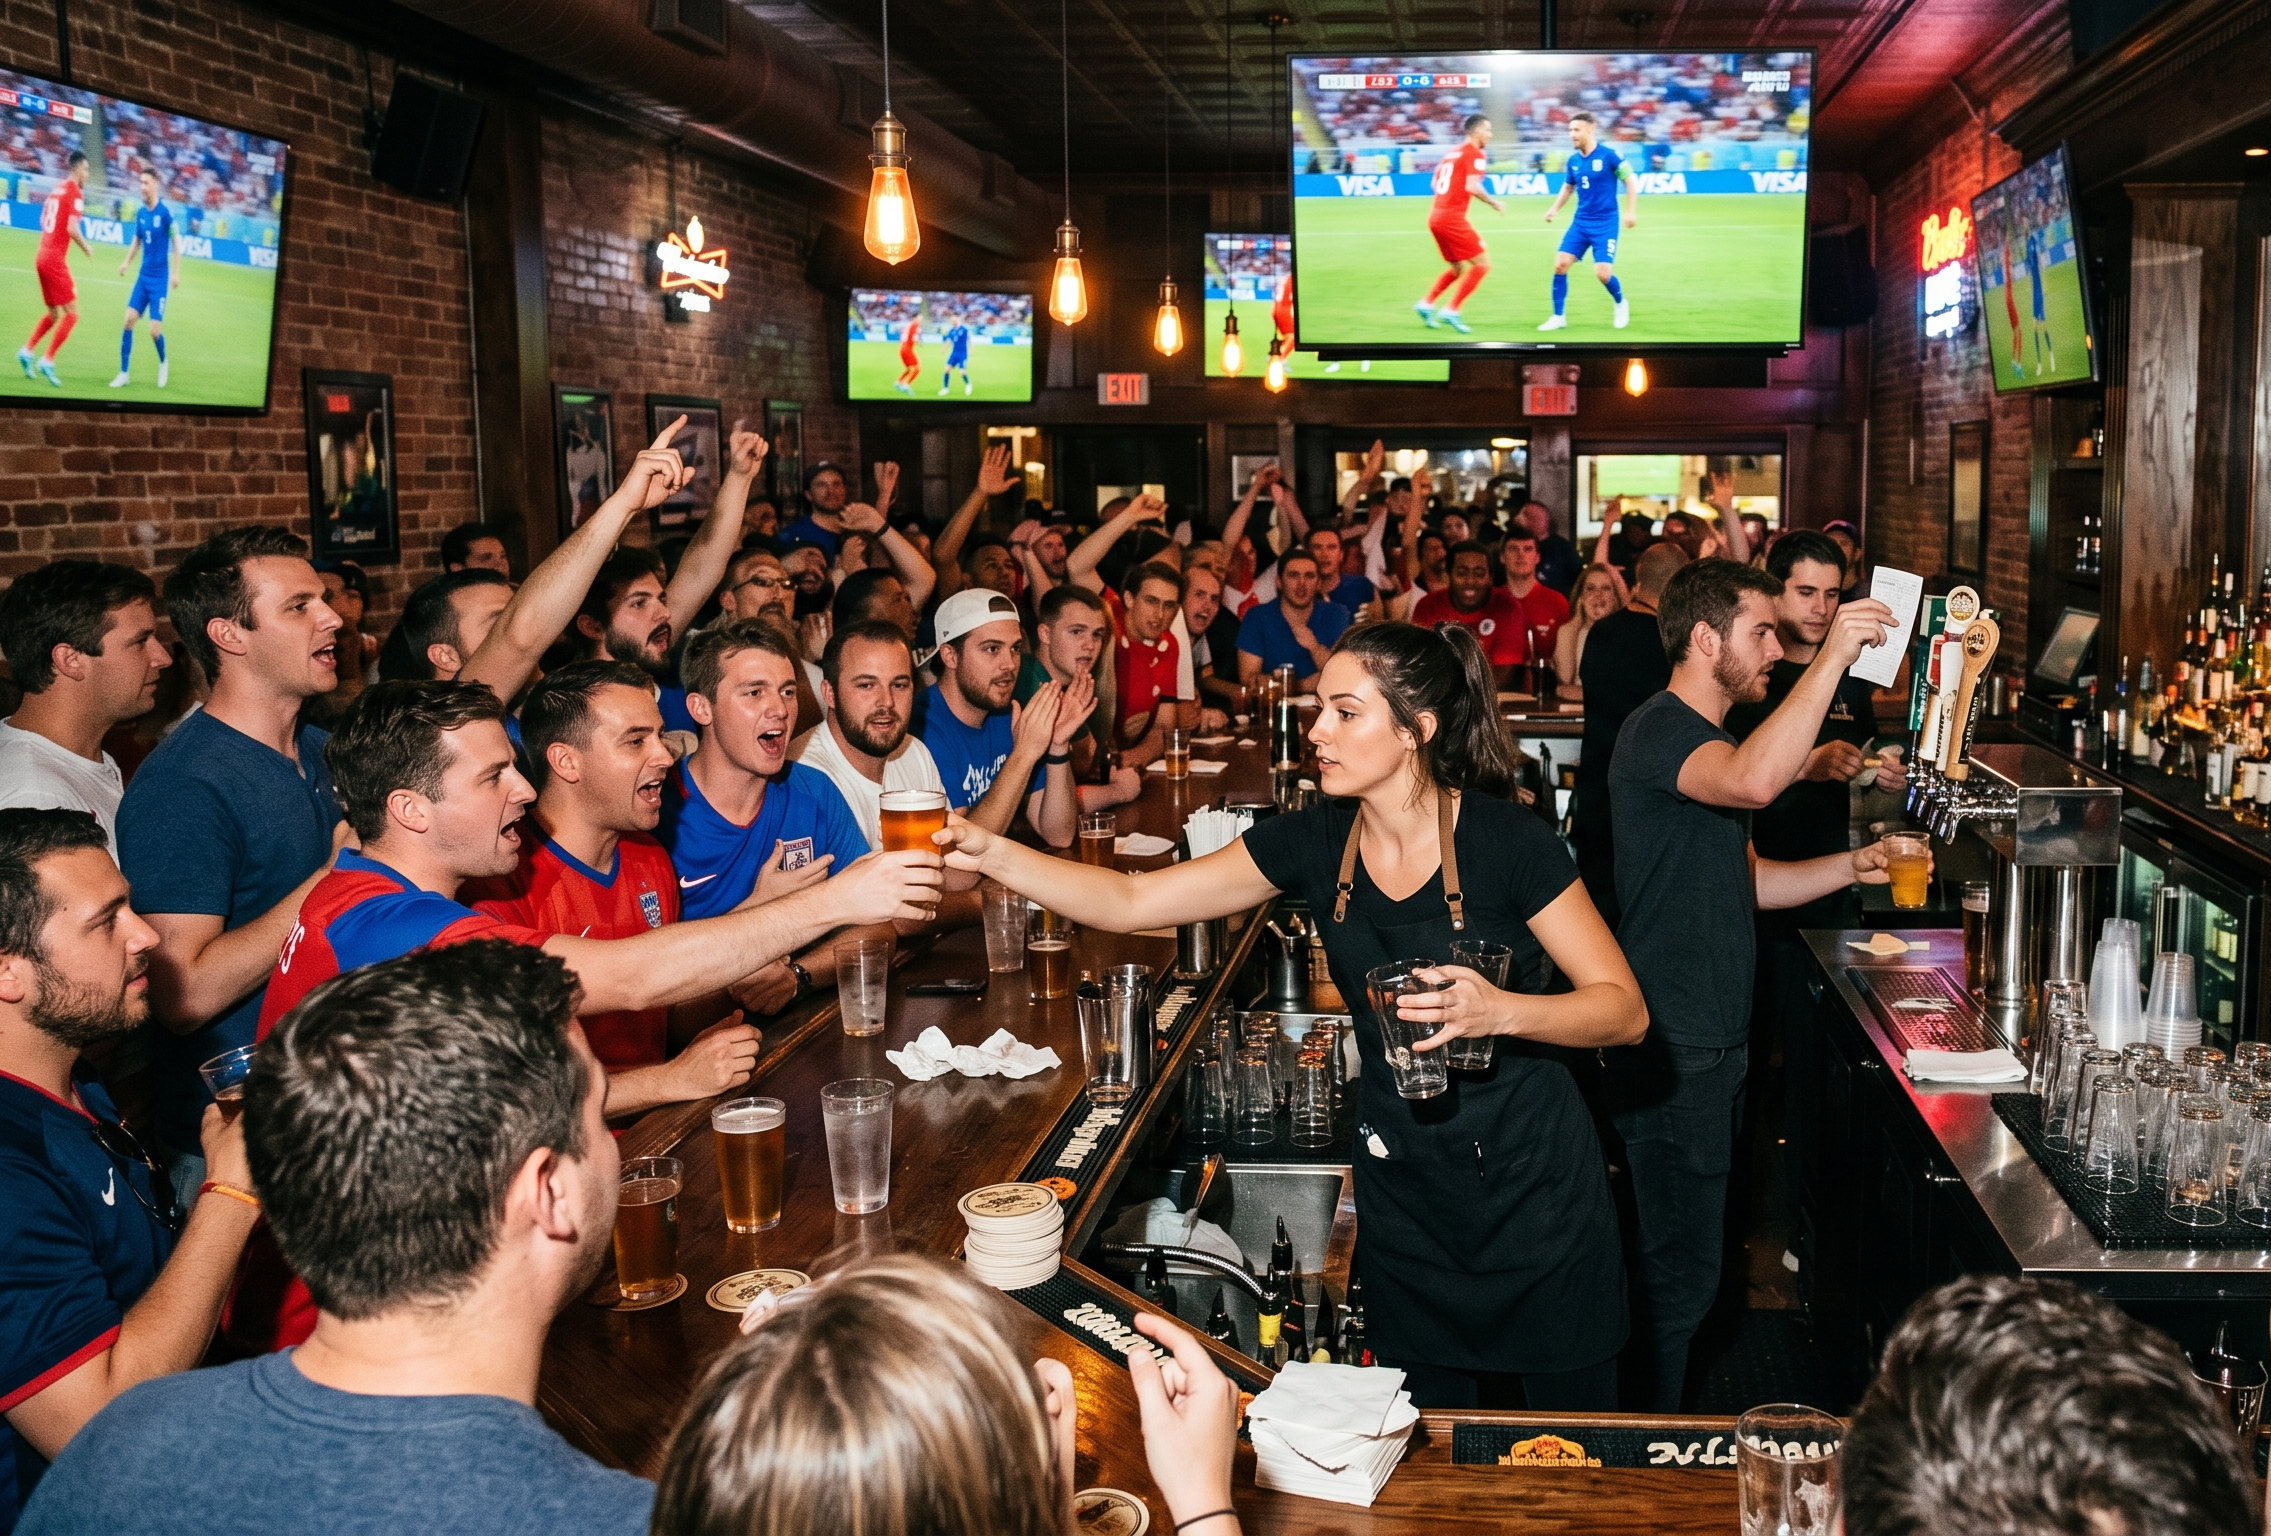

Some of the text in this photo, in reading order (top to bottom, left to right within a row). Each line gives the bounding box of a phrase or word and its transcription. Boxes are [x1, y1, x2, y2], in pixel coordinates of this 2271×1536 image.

[1334, 175, 1395, 196] VISA
[1486, 173, 1550, 195] VISA
[1630, 172, 1688, 194] VISA
[1748, 171, 1807, 192] VISA
[83, 217, 124, 244] VISA
[1106, 374, 1143, 403] EXIT
